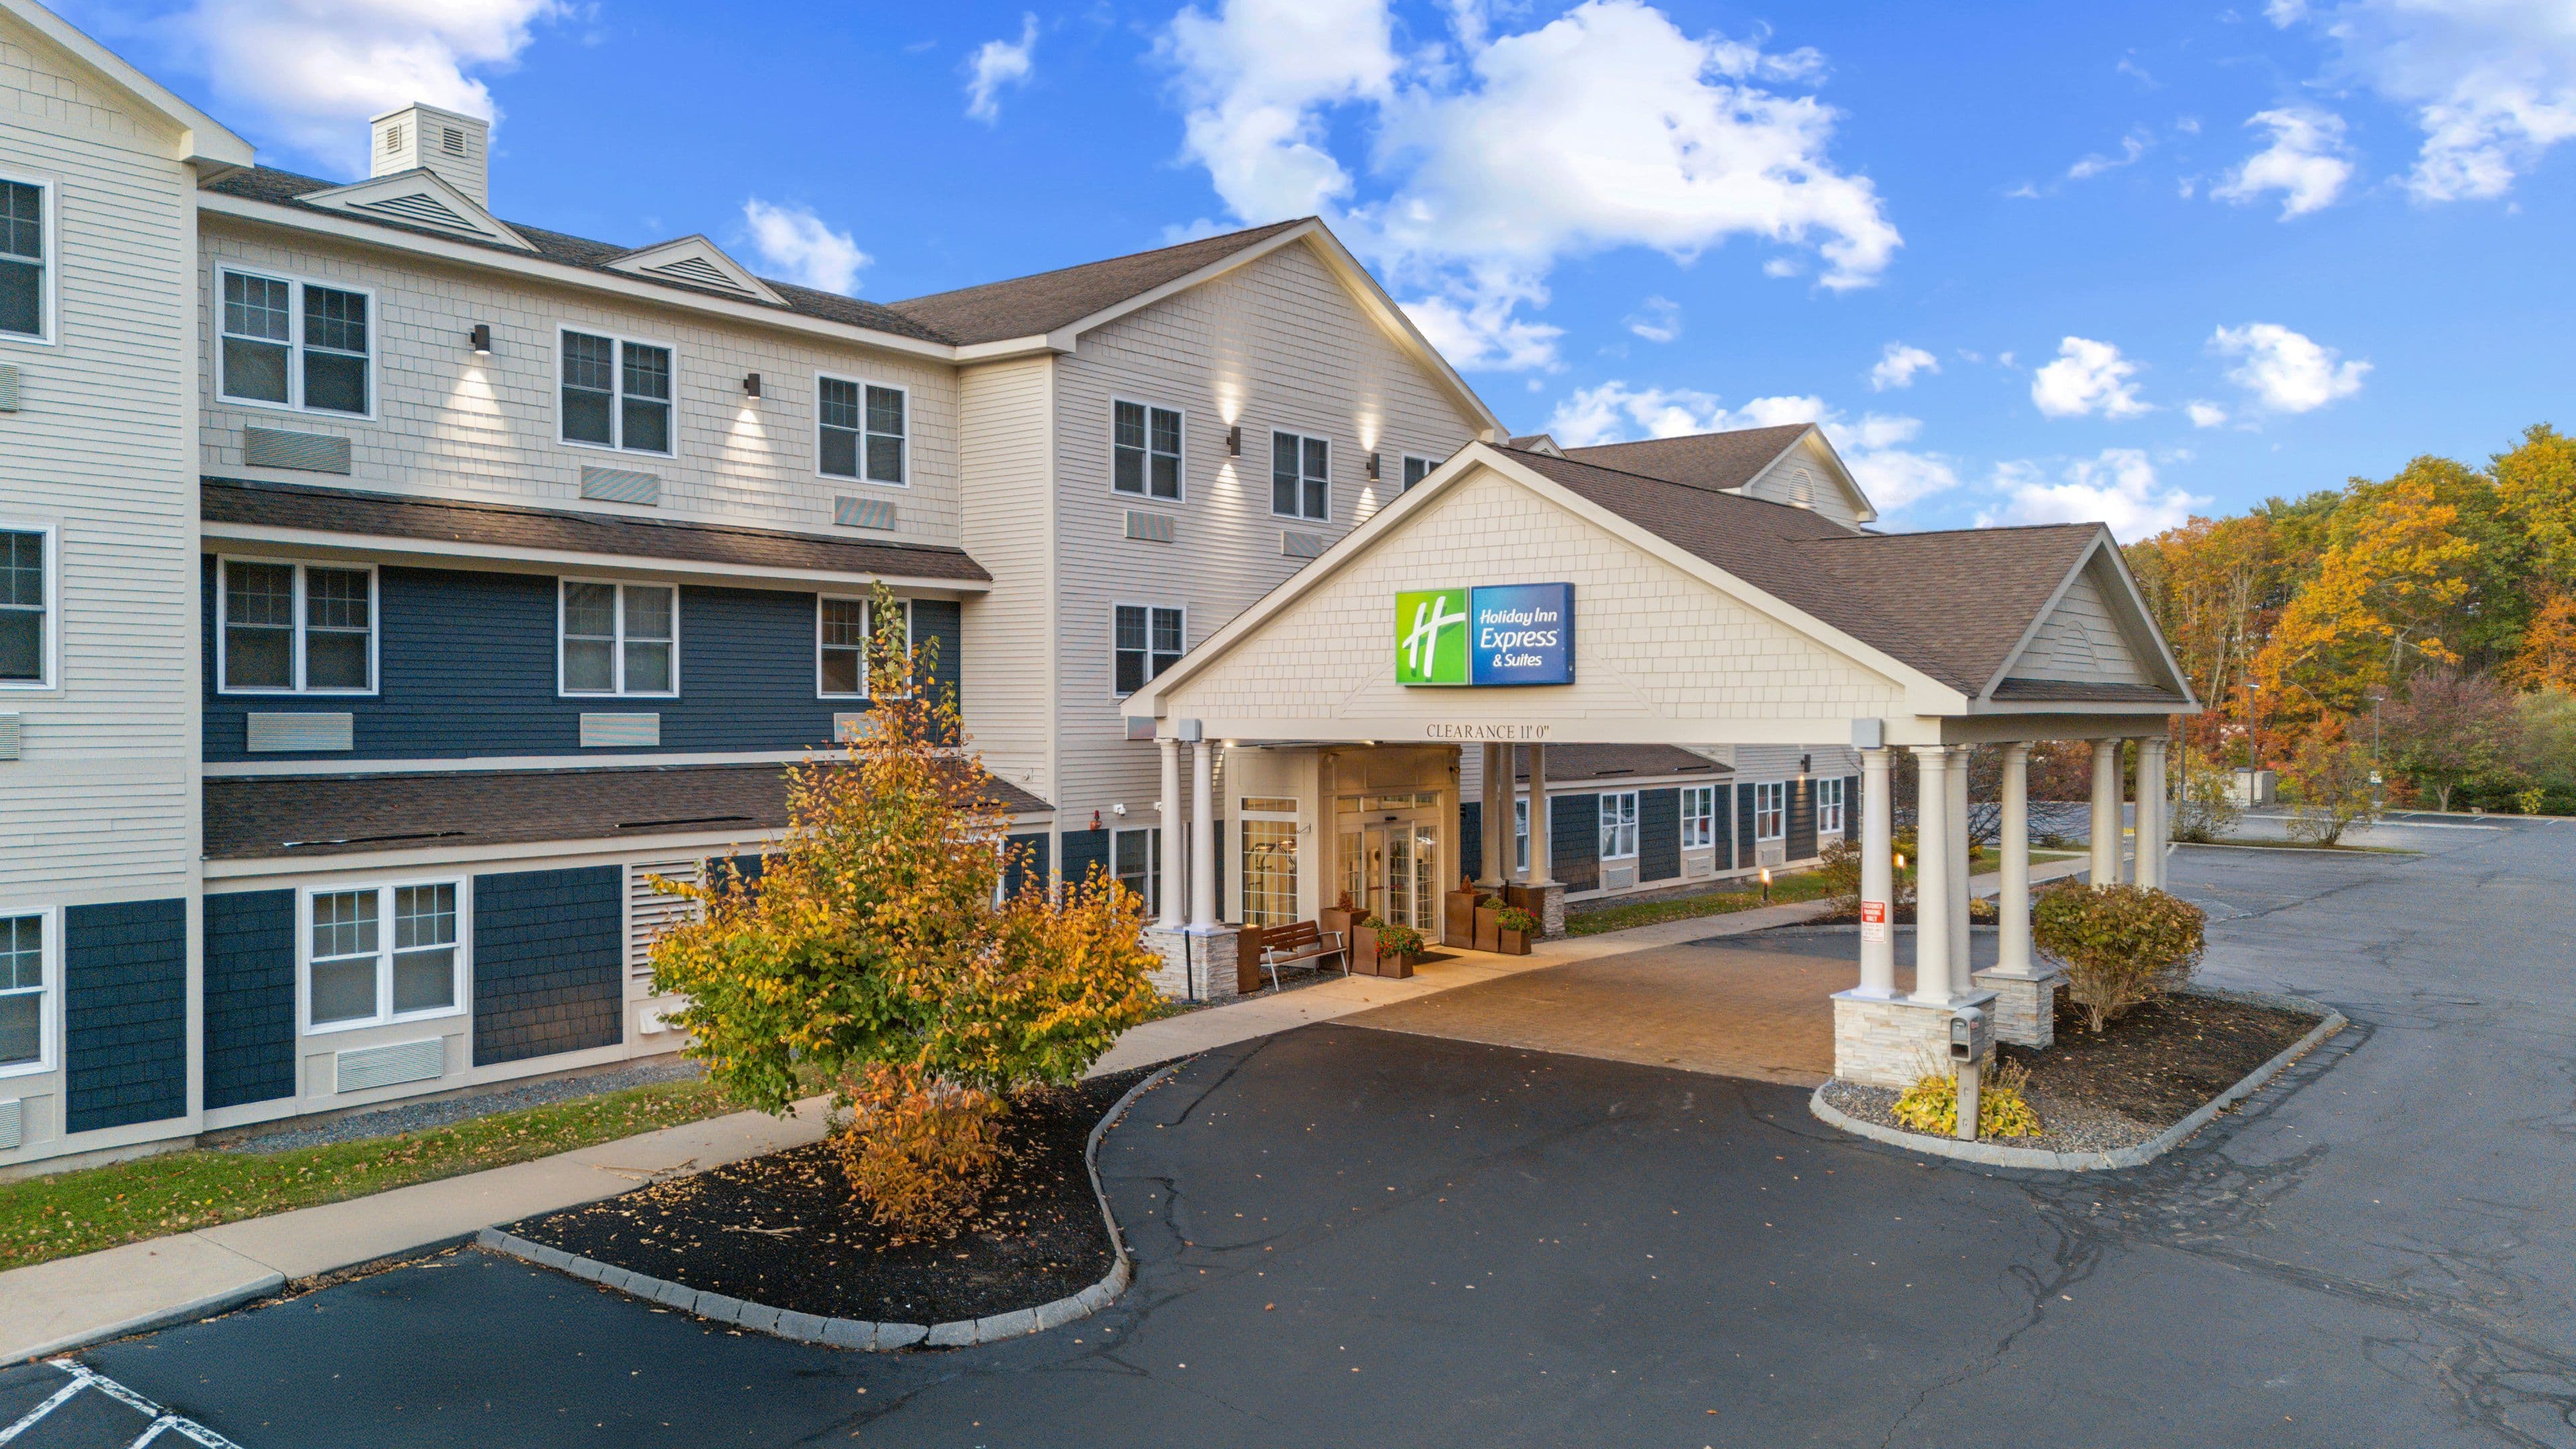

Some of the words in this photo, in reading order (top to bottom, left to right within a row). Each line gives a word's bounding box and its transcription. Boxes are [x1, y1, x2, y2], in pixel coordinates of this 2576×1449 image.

[1480, 608, 1533, 626] Holiday
[1534, 606, 1558, 623] Inn
[1480, 627, 1558, 653] Express
[1493, 653, 1502, 667] &
[1504, 653, 1542, 667] Suites
[1427, 724, 1515, 739] CLEARANCE
